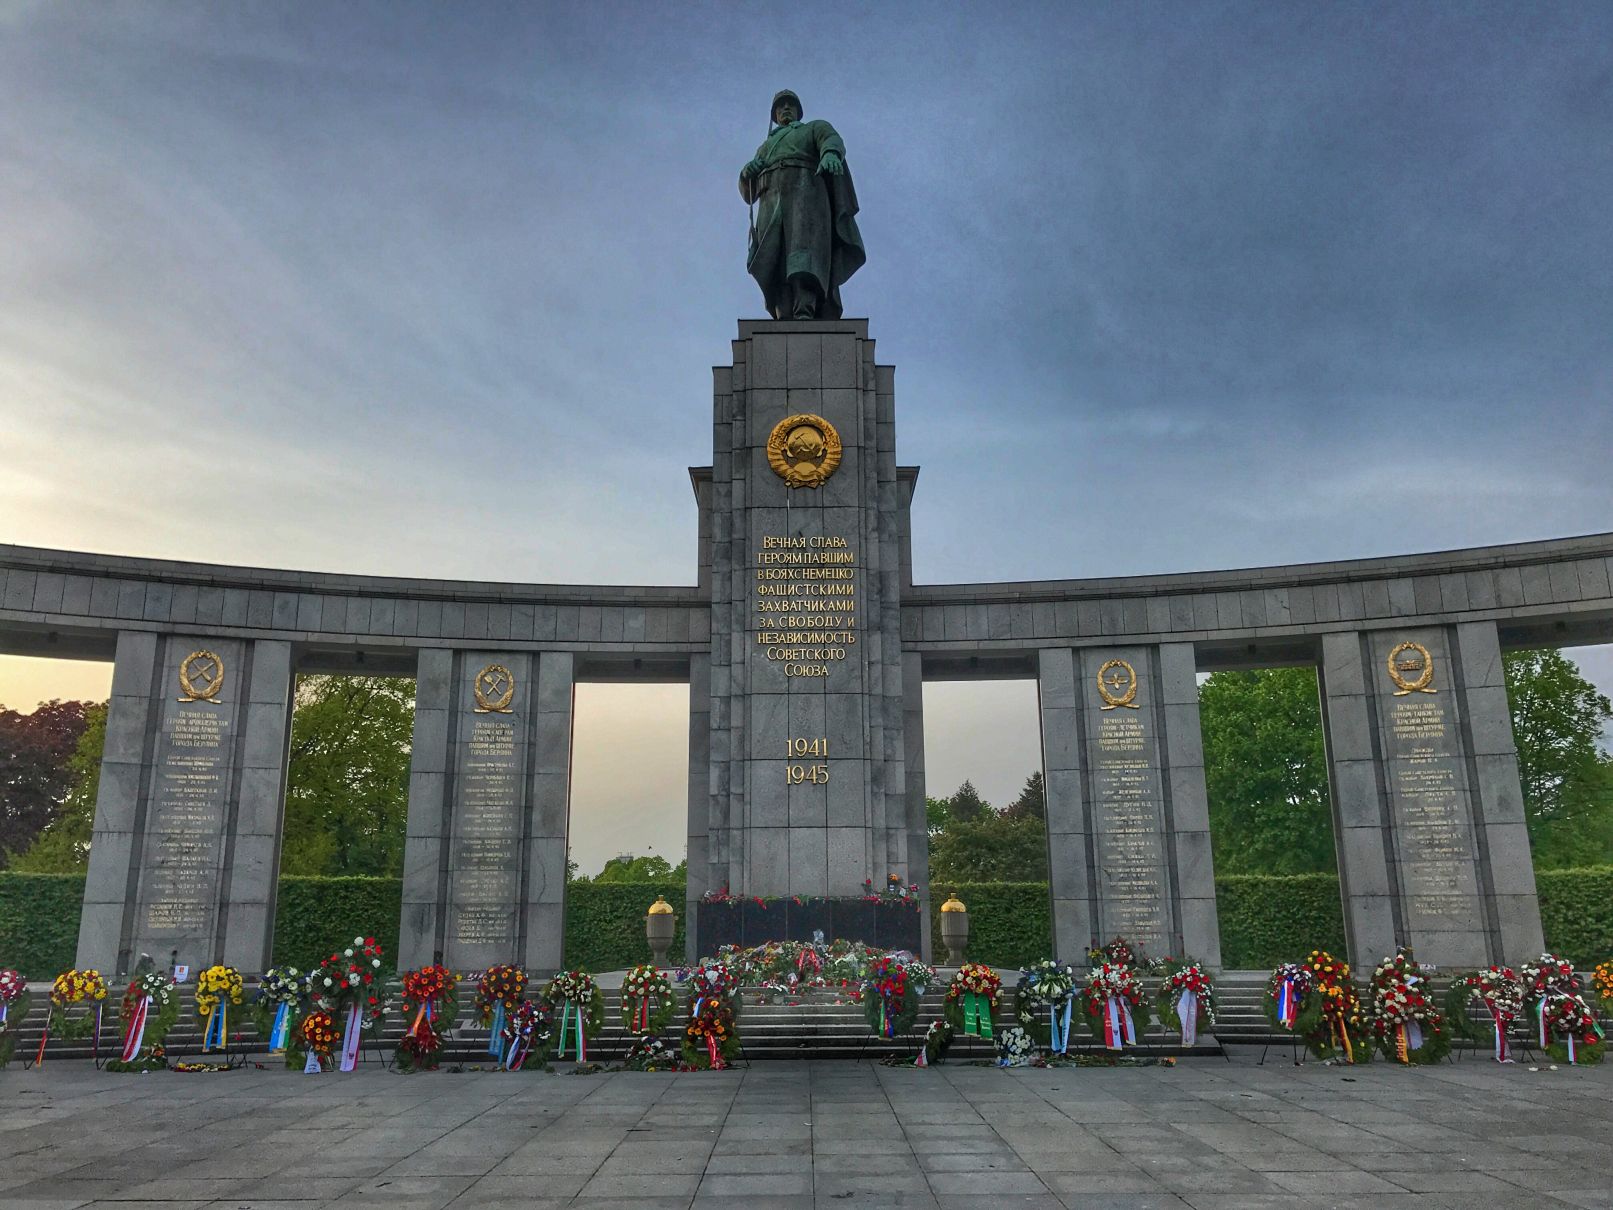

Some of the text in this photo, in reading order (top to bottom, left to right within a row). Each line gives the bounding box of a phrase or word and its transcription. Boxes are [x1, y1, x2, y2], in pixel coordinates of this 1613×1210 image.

[763, 536, 848, 549] ВЕЧНАЯ СЛАВА
[757, 552, 854, 564] ГЕРОЯМ ПАВШИМ
[757, 569, 765, 580] В
[766, 568, 795, 580] БОЯХ
[802, 568, 854, 580] НЕМЕЦКО
[757, 583, 854, 597] ФАШИСТСКИМИ
[757, 600, 854, 612] ЗАХВАТЧИКАМИ
[759, 617, 775, 628] ЗА
[779, 615, 843, 628] СВОБОДУ
[757, 632, 856, 645] НЕЗАВИСИМОСТЬ
[766, 646, 846, 661] СОВЕТСКОГО
[784, 663, 829, 677] СОЮЗА
[786, 737, 829, 757] 1941
[785, 765, 829, 785] 1945
